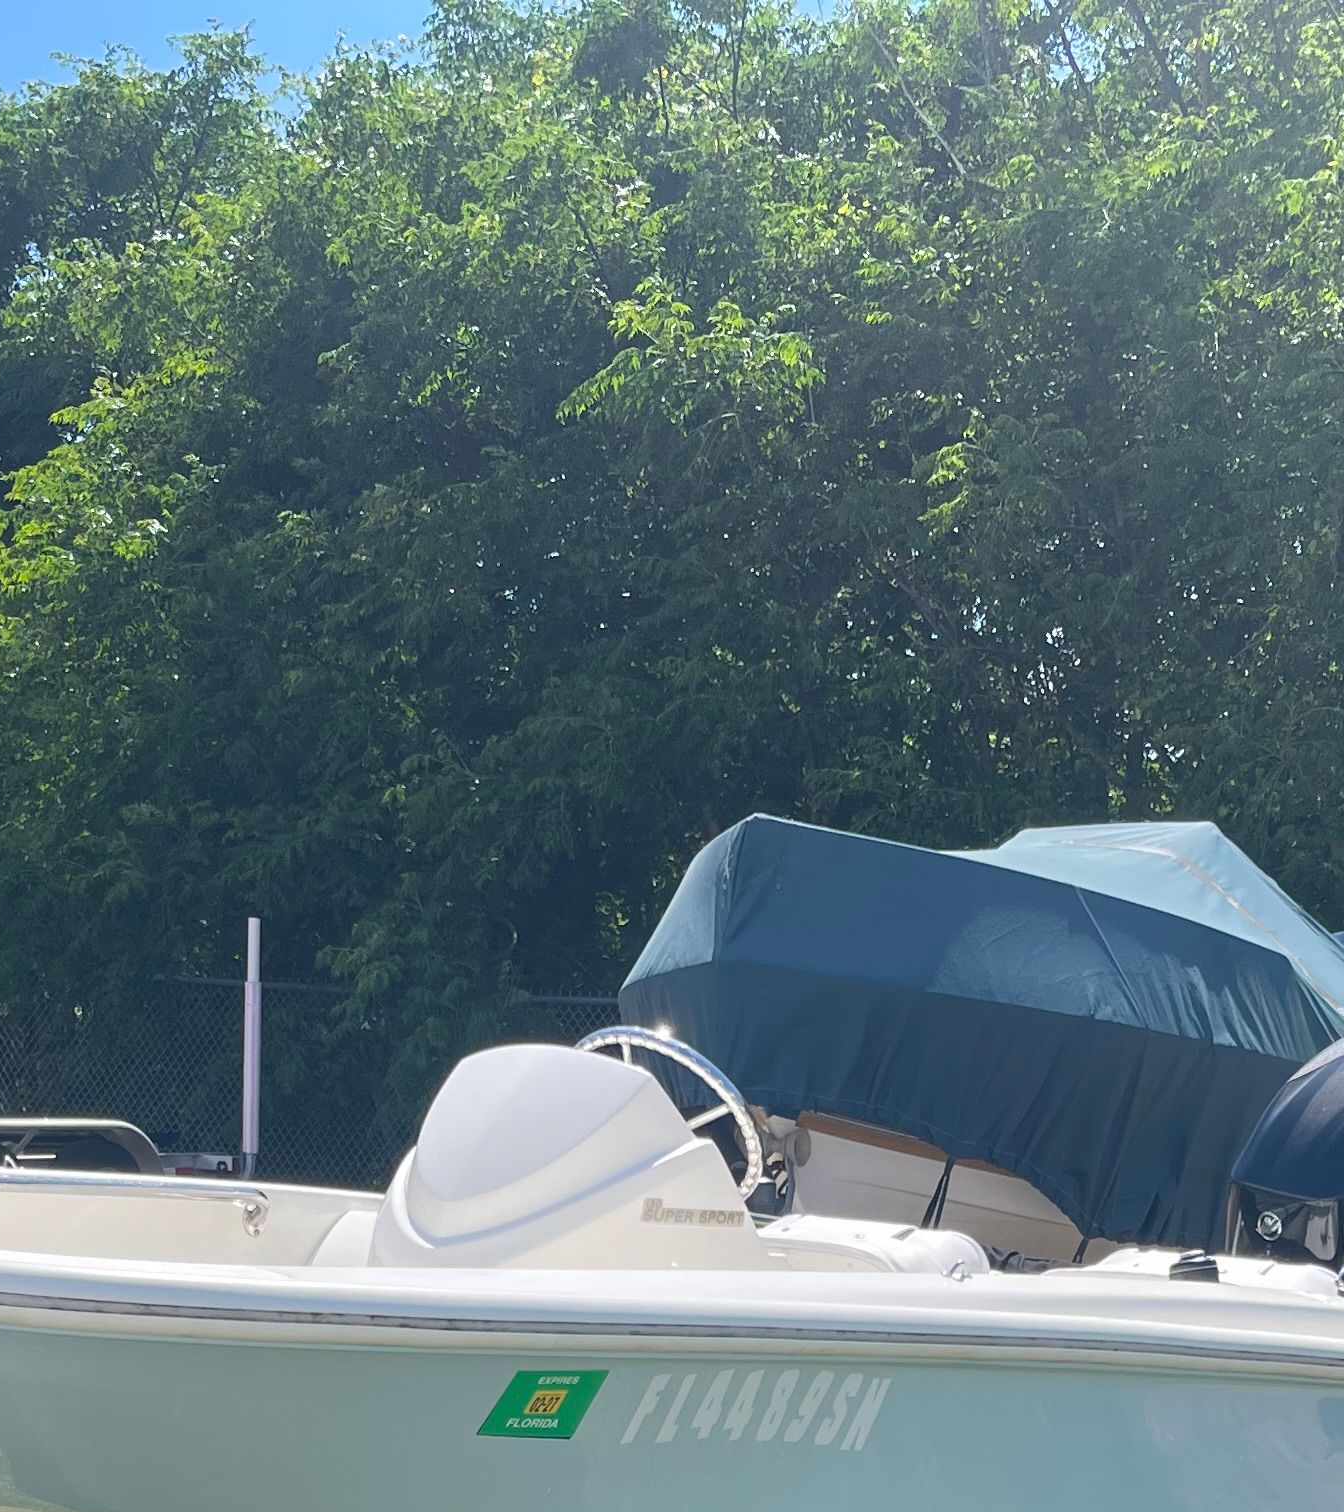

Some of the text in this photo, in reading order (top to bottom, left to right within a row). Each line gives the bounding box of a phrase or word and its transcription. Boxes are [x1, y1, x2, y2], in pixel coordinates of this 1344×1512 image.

[642, 1208, 745, 1225] SUPER SPORT
[538, 1376, 580, 1385] EXPIRES
[506, 1418, 560, 1429] FLORIDA
